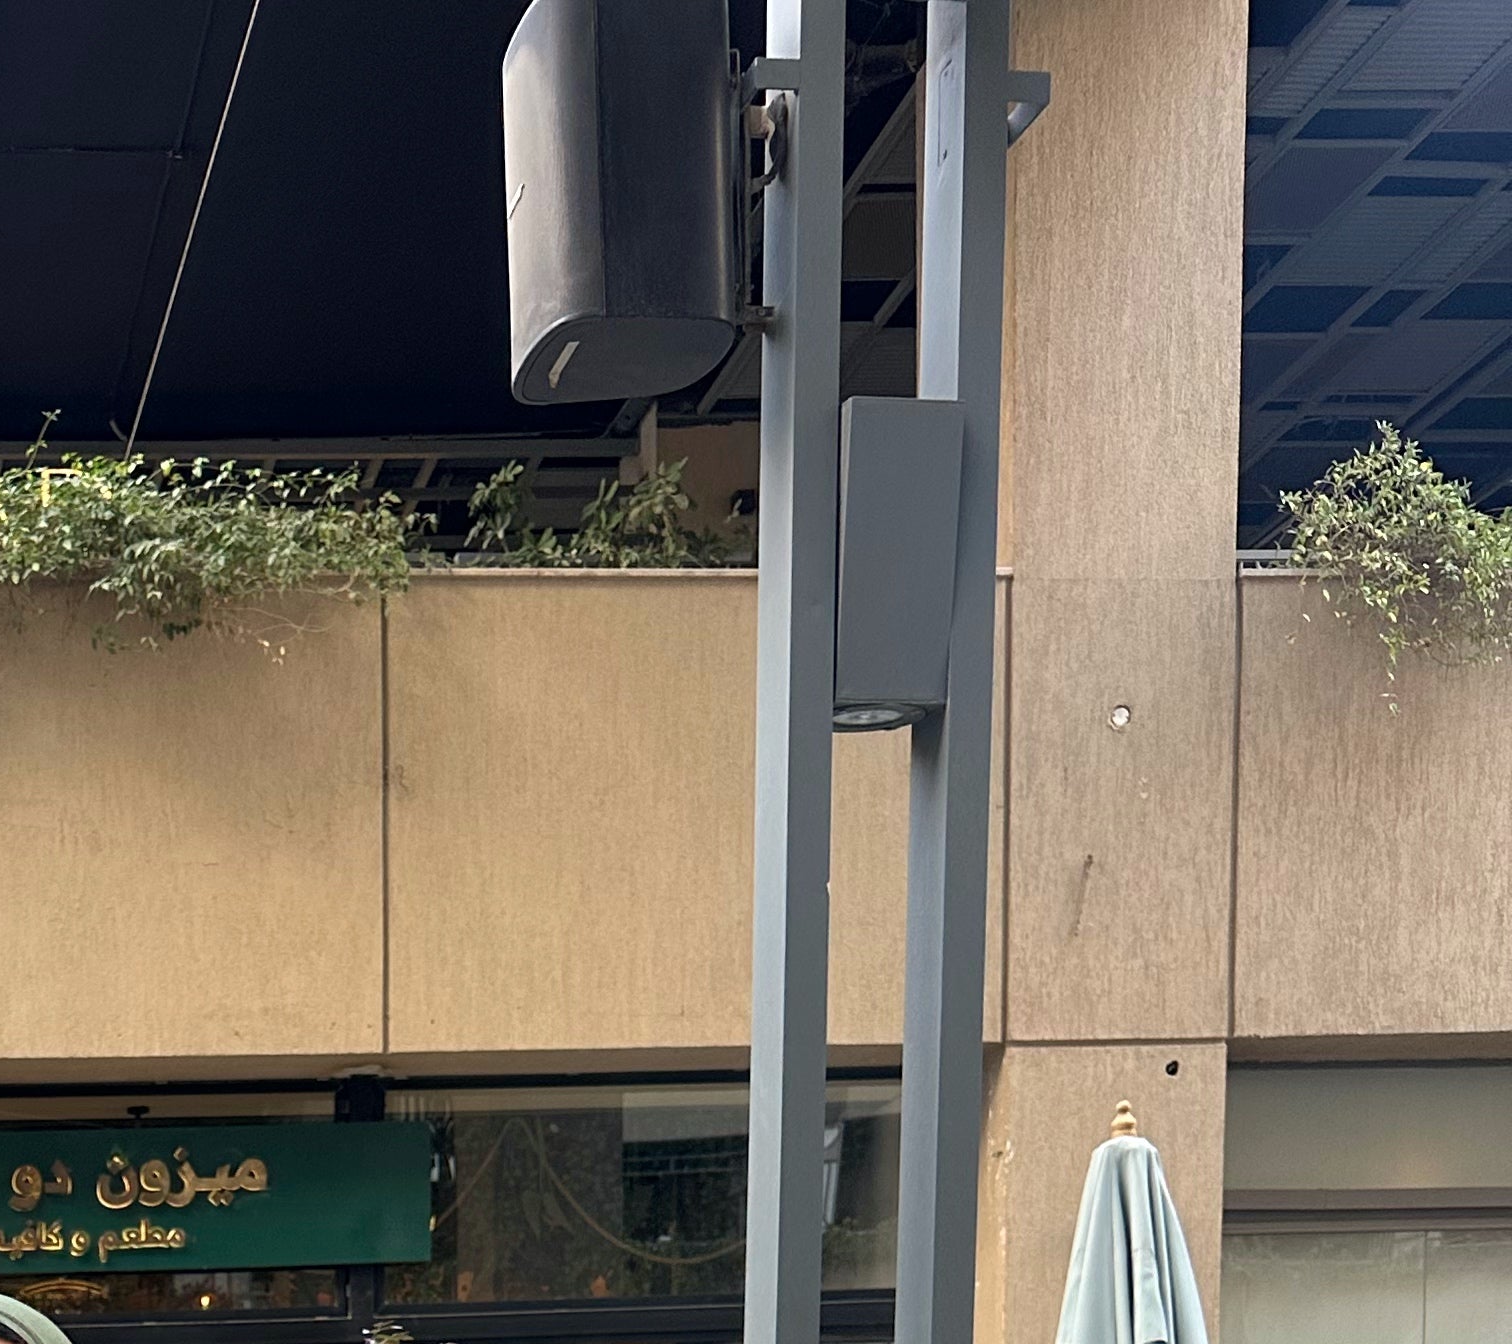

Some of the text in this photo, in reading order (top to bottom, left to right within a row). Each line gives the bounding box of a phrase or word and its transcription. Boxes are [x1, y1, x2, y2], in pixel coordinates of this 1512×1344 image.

[7, 1158, 74, 1213] دو
[95, 1146, 269, 1210] ميزون
[69, 1229, 91, 1258] و
[97, 1217, 187, 1265] مطعم
